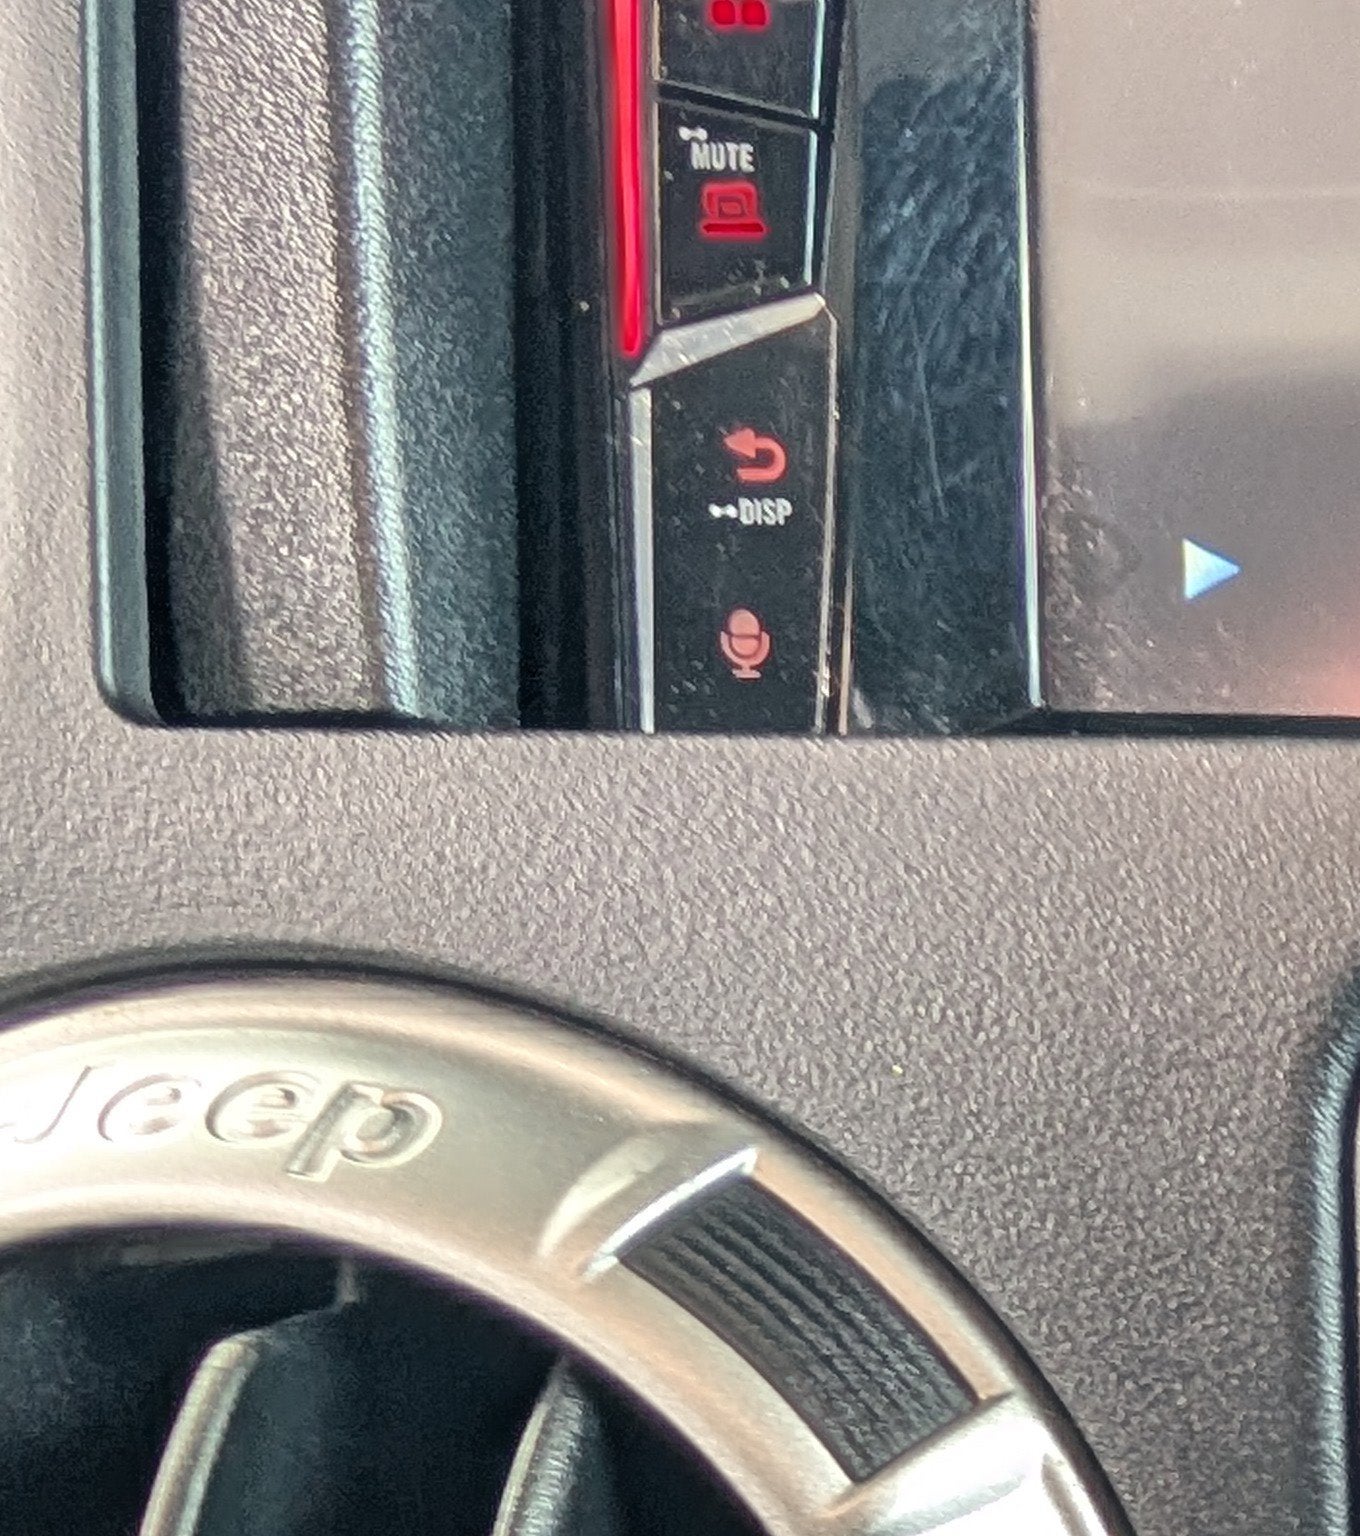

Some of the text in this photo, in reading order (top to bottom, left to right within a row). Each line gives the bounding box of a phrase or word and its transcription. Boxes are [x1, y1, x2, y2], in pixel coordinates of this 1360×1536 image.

[691, 141, 755, 172] MUTE
[738, 497, 793, 526] DISP
[0, 1064, 444, 1182] Jeep
